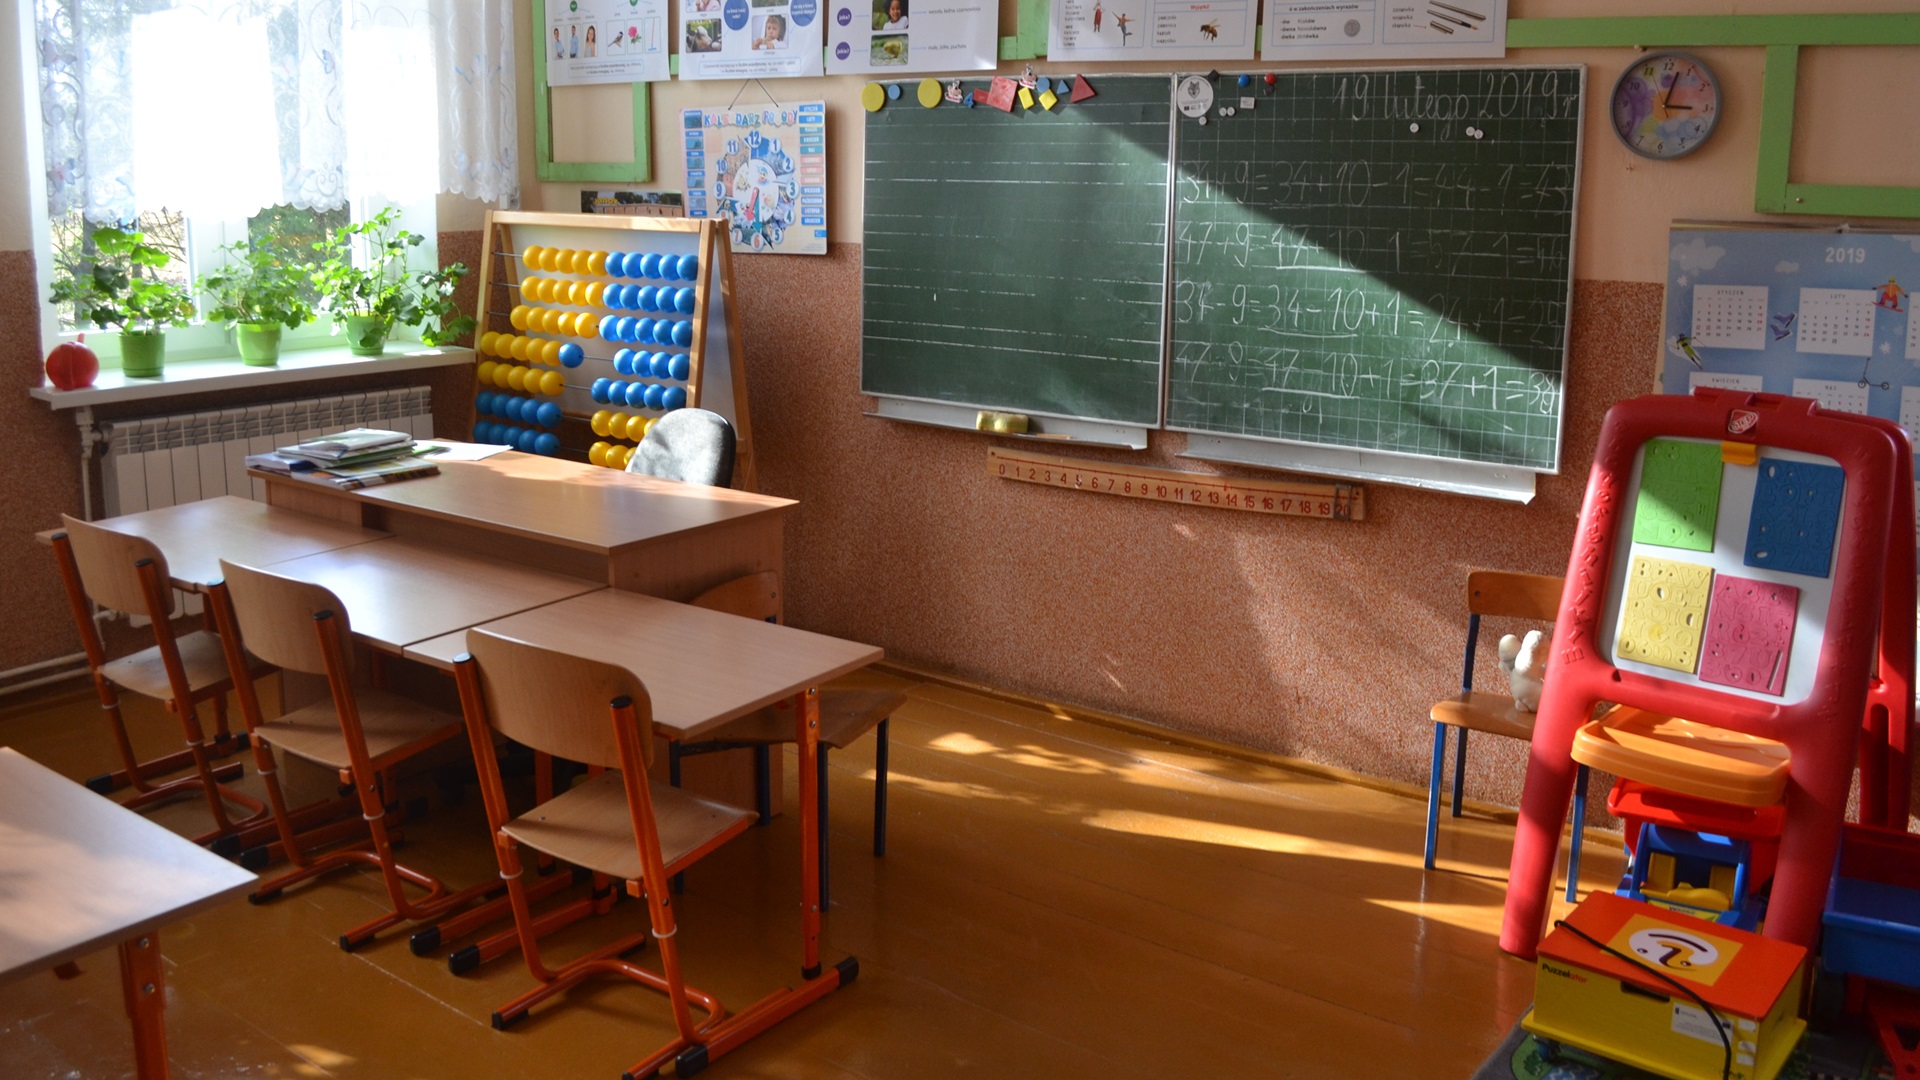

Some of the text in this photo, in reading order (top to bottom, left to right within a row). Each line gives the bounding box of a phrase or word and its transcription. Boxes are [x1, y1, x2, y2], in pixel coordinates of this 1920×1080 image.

[1643, 66, 1654, 76] 11
[1663, 62, 1674, 71] 12
[1333, 73, 1370, 122] 19
[1384, 73, 1470, 142] lutego
[704, 109, 798, 127] KALEDARZ POODY
[749, 131, 761, 145] 12
[728, 141, 737, 153] 11
[716, 159, 726, 172] 10
[785, 158, 791, 170] 2
[716, 182, 722, 197] 9
[789, 181, 796, 197] 3
[786, 210, 792, 222] 4
[734, 229, 740, 241] 7
[754, 235, 760, 249] 6
[774, 229, 780, 241] 5
[1825, 247, 1866, 264] 2019
[999, 464, 1006, 475] 0
[1029, 468, 1036, 480] 2
[1044, 470, 1051, 482] 3
[1060, 473, 1067, 485] 4
[1092, 477, 1099, 489] 6
[1108, 479, 1116, 491] 7
[1125, 481, 1132, 493] 8
[1141, 483, 1149, 495] 9
[1156, 485, 1168, 498] 10
[1174, 487, 1184, 500] 11
[1190, 489, 1202, 503] 12
[1207, 491, 1220, 504] 13
[1225, 493, 1238, 507] 14
[1244, 495, 1256, 508] 15
[1262, 497, 1274, 510] 16
[1280, 499, 1293, 511] 17
[1299, 501, 1312, 514] 18
[1317, 502, 1331, 516] 19
[1541, 962, 1588, 984] Puzzelator
